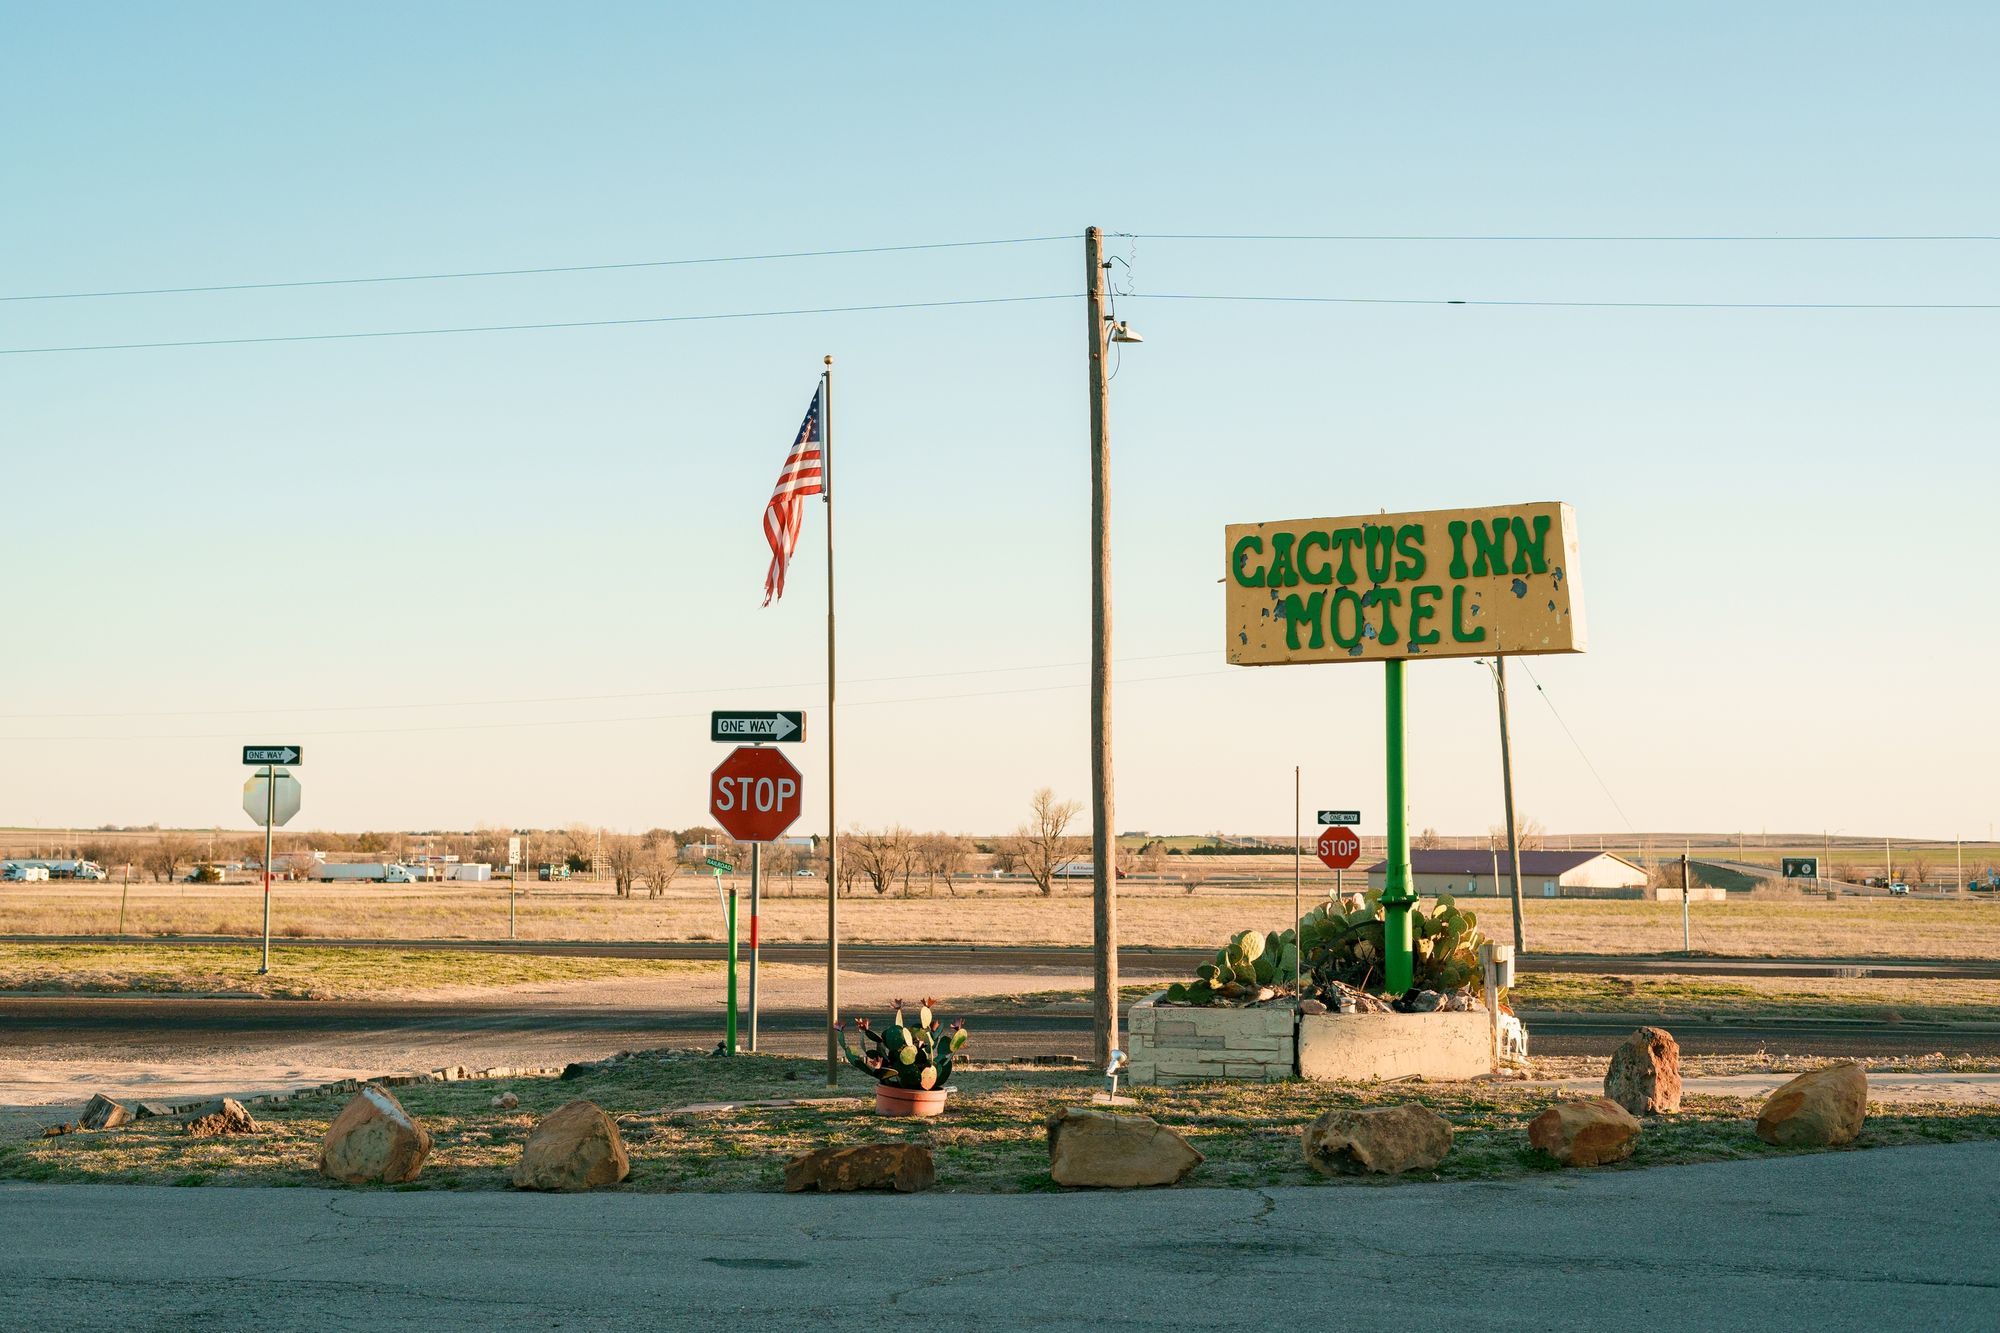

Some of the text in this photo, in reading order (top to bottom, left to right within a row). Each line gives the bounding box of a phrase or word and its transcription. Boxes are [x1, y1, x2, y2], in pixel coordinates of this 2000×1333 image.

[1232, 515, 1551, 587] CACTUS INN
[1285, 584, 1485, 650] MOTEL
[720, 720, 775, 732] ONE WAY
[248, 751, 283, 759] ONE WAY
[716, 776, 796, 812] STOP
[1320, 840, 1358, 856] STOP
[707, 858, 732, 870] RAILROAD
